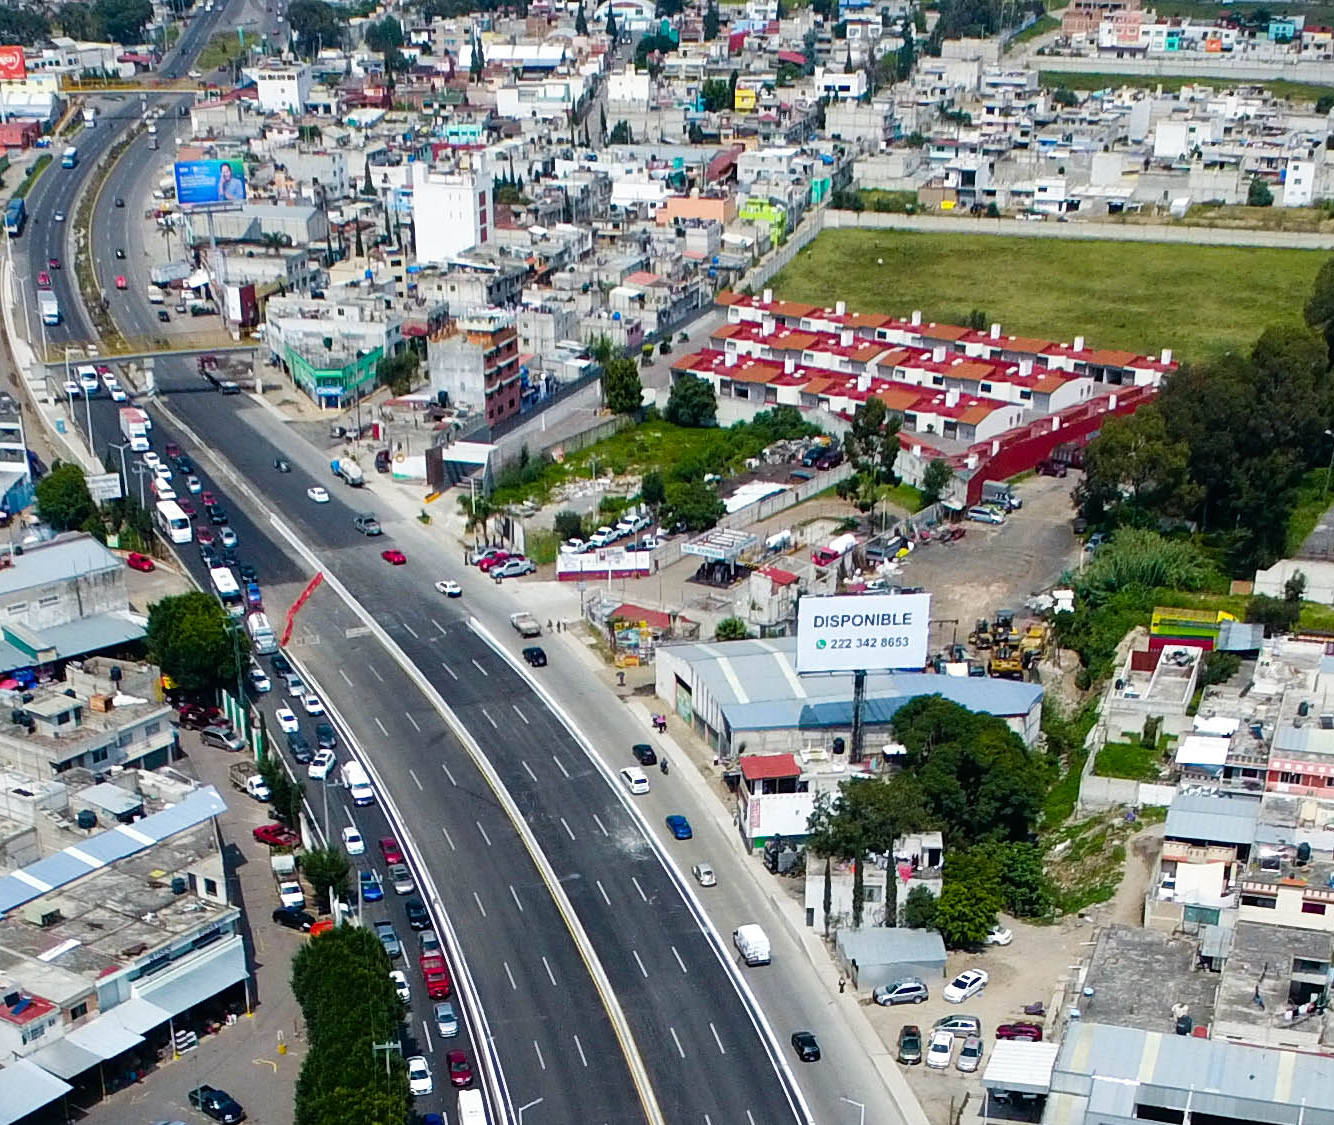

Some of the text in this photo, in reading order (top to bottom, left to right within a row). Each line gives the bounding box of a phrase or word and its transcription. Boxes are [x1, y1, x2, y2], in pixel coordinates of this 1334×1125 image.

[813, 612, 913, 628] DISPONIBLE
[830, 636, 909, 649] 222 342 8653
